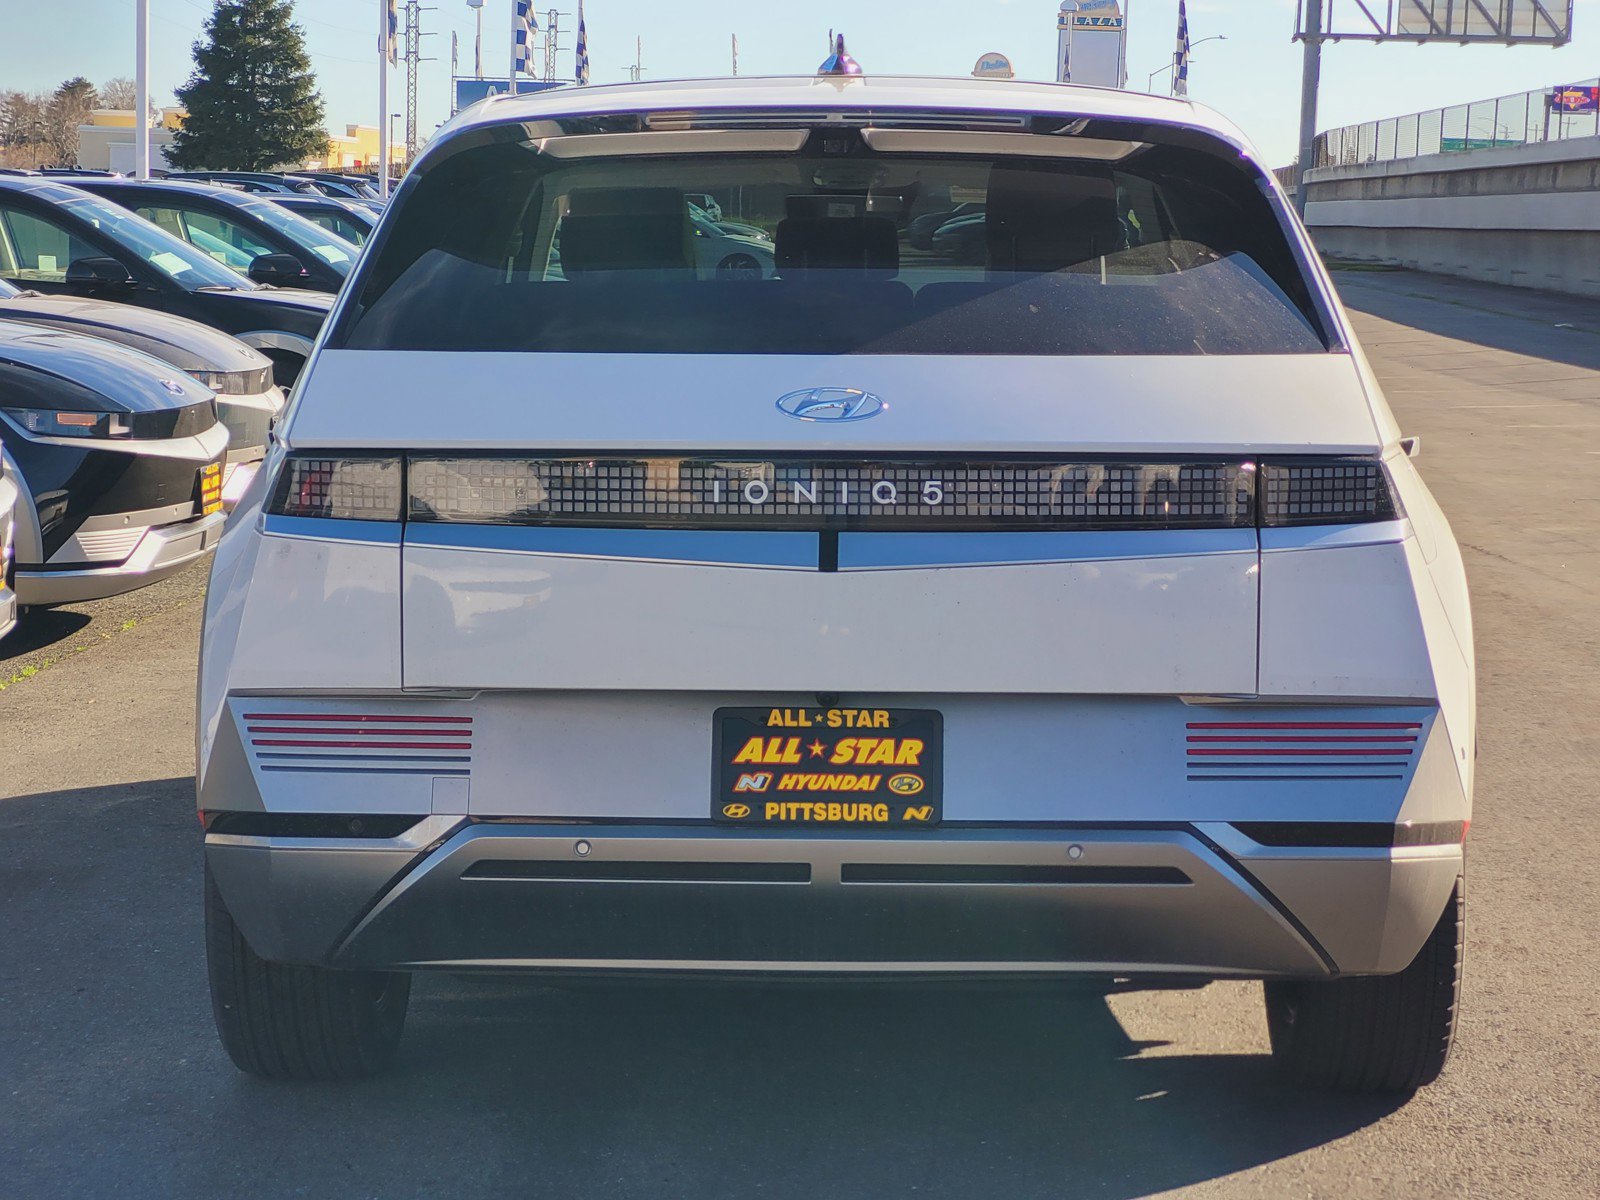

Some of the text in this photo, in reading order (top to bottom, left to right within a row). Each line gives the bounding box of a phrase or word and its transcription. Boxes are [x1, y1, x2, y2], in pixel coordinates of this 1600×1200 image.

[713, 480, 943, 505] IONIQ 5
[767, 709, 890, 728] ALL STAR
[732, 736, 924, 766] ALL STAR
[776, 773, 883, 792] HYUNDAI
[765, 802, 889, 822] PITTSBURG
